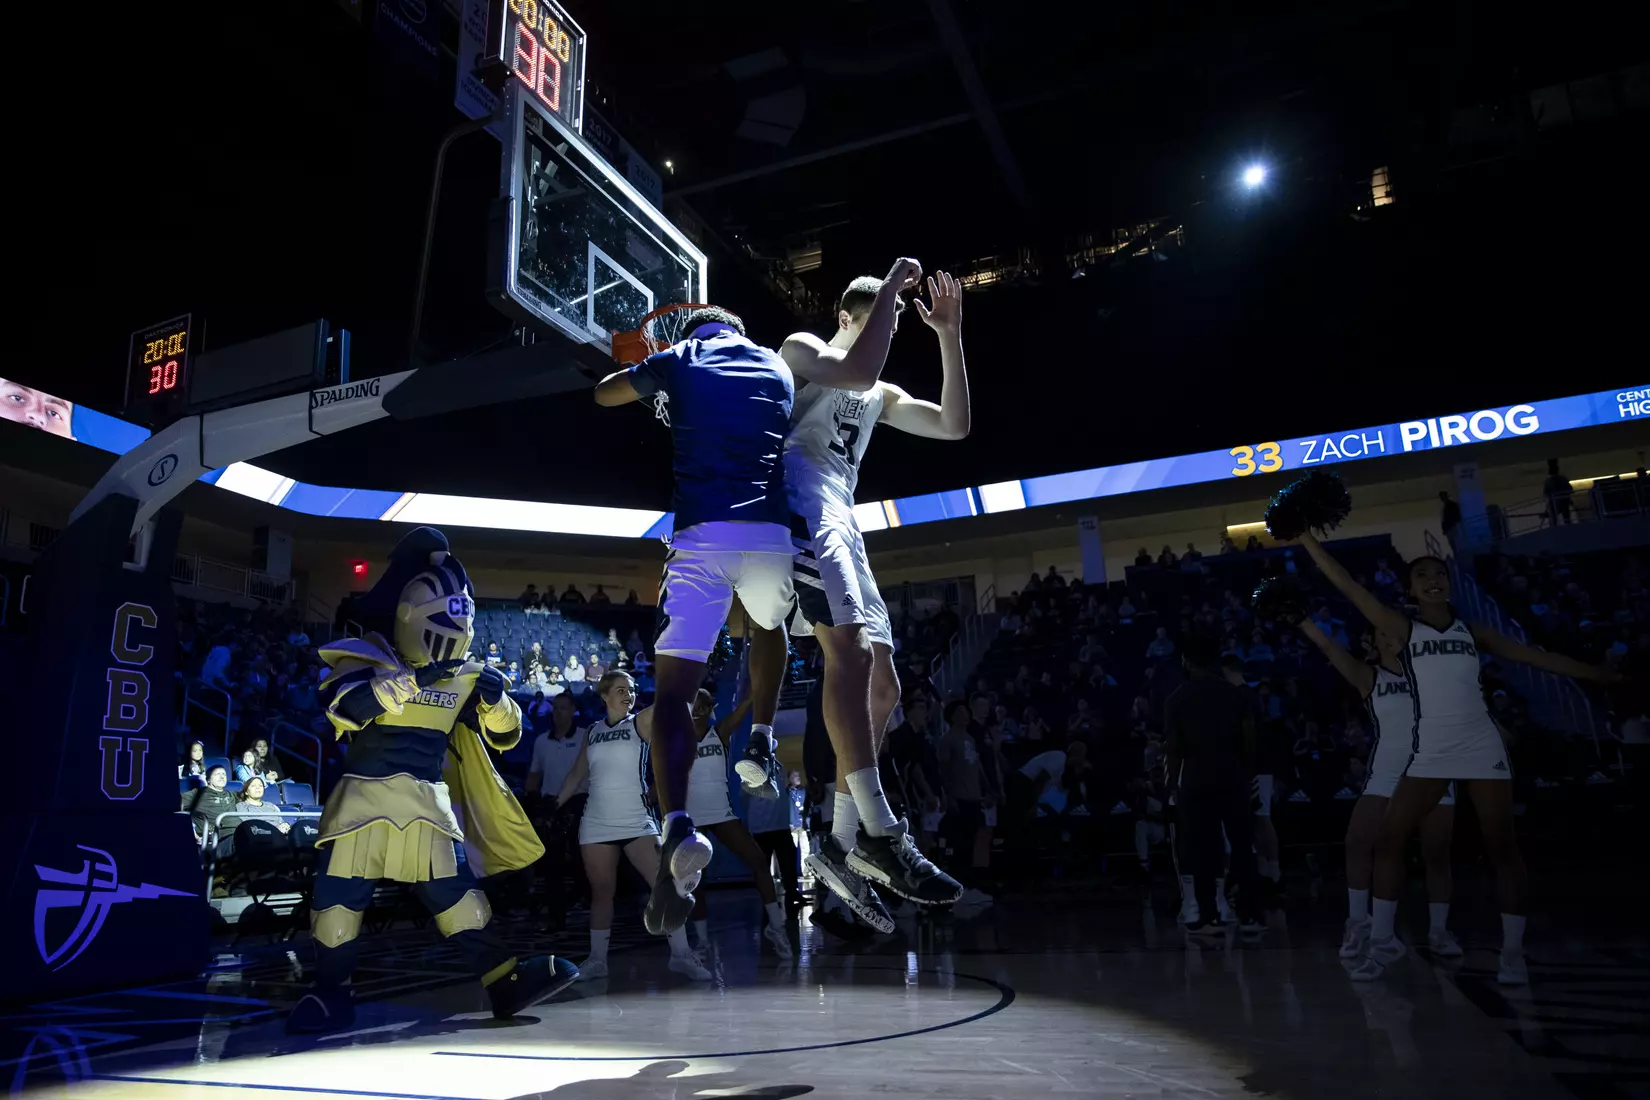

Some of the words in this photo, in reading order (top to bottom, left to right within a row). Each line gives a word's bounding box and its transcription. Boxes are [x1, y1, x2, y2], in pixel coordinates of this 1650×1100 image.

[513, 22, 561, 112] 30
[148, 359, 178, 395] 30
[311, 378, 380, 410] SPALDING
[1229, 441, 1283, 477] 33
[1300, 430, 1385, 464] ZACH
[1400, 404, 1540, 452] PIROG
[1411, 639, 1476, 658] LANCERS
[98, 601, 158, 801] CBU
[588, 729, 631, 746] LANCERS
